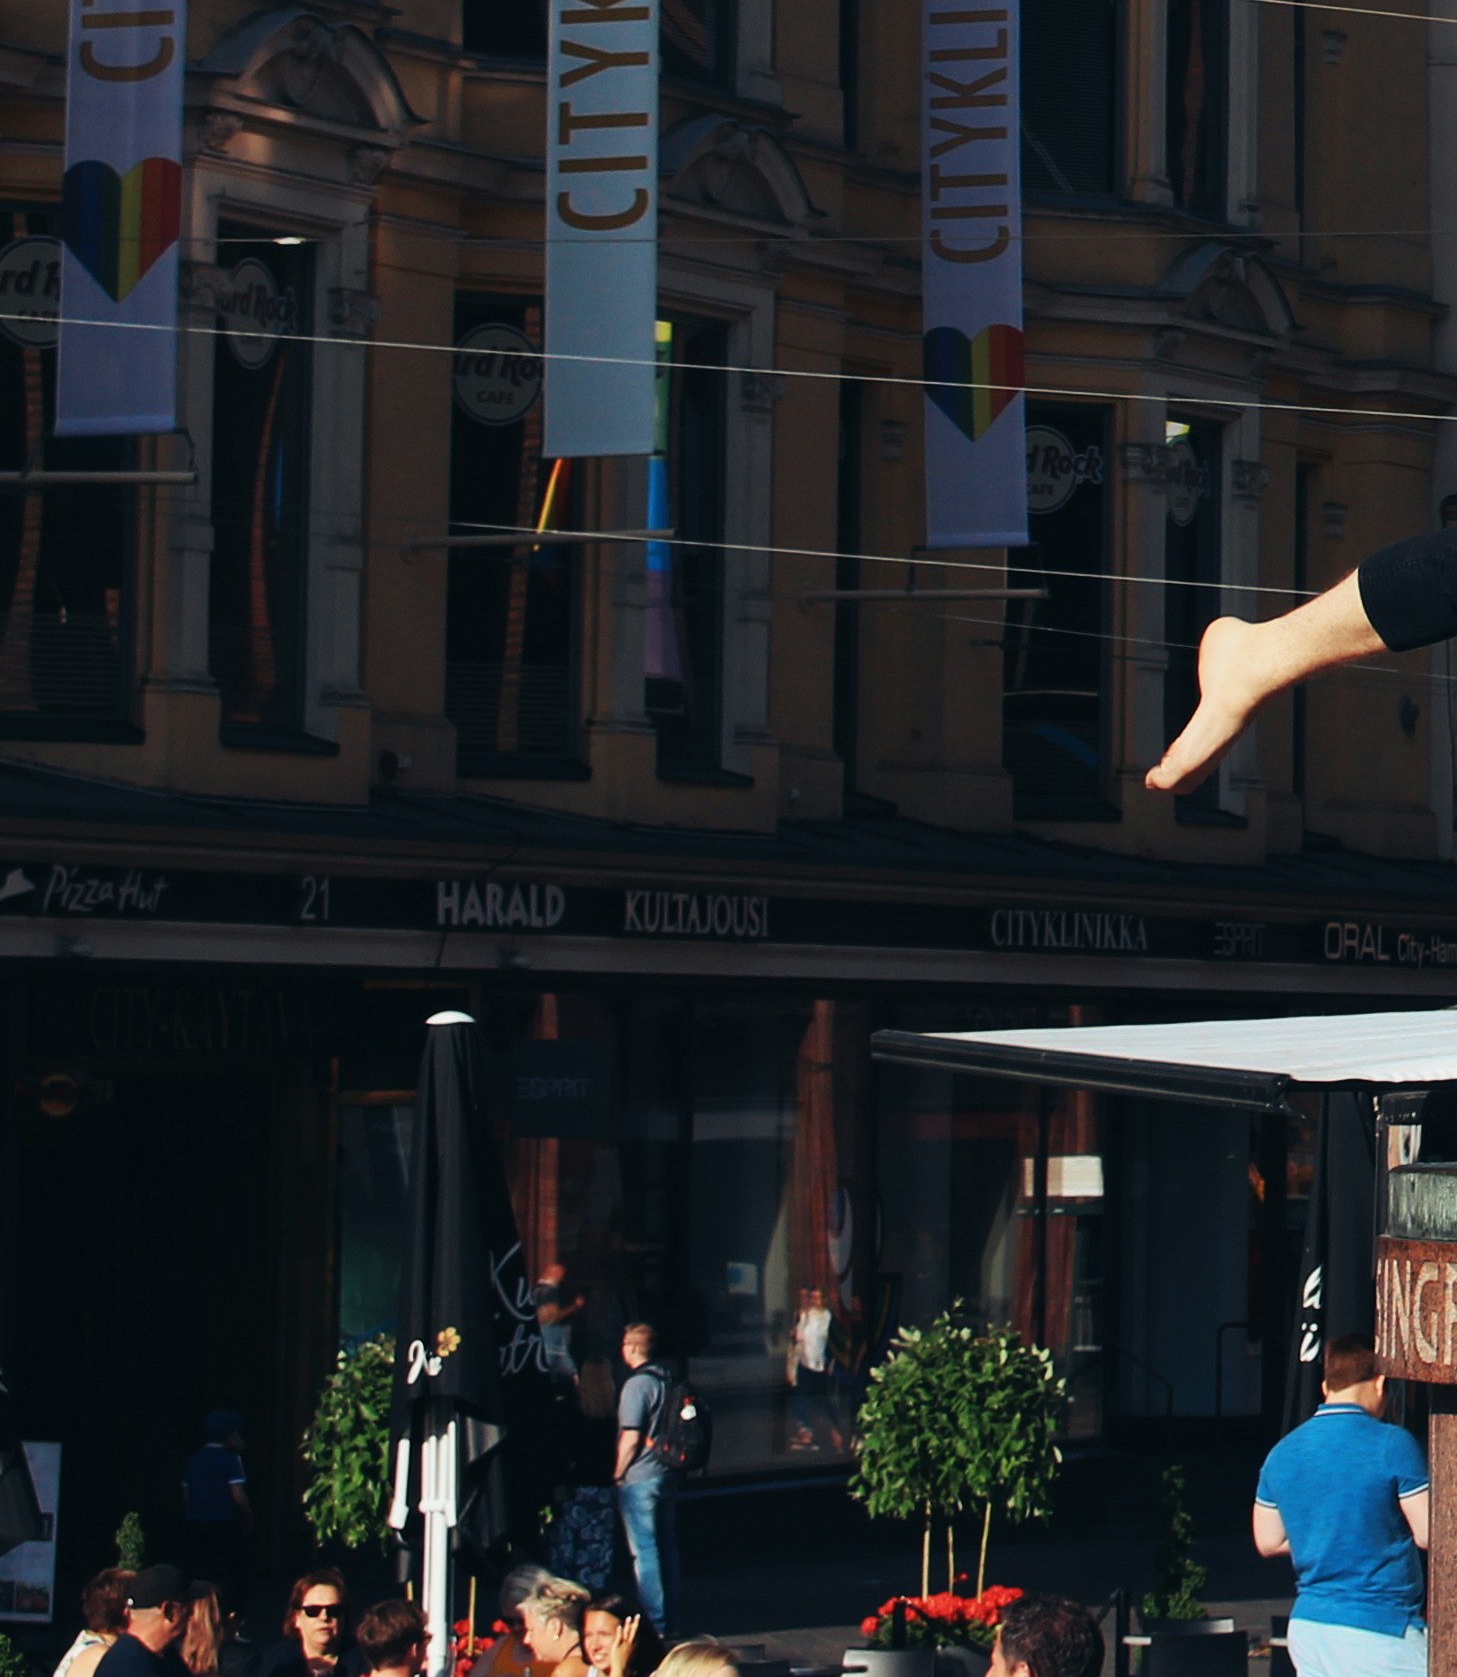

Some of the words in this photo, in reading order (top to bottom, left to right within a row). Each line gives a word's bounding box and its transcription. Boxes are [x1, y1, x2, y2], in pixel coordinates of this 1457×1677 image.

[1041, 444, 1102, 483] Rock
[42, 864, 115, 914] Pizza
[117, 868, 171, 912] Hut
[300, 875, 330, 920] 21
[437, 880, 566, 928] HARALD
[623, 888, 769, 938] KULTAJOUSI
[990, 908, 1149, 951] CITYKLINIKKA
[1324, 921, 1390, 961] ORAL
[516, 1077, 592, 1100] ESPRIT
